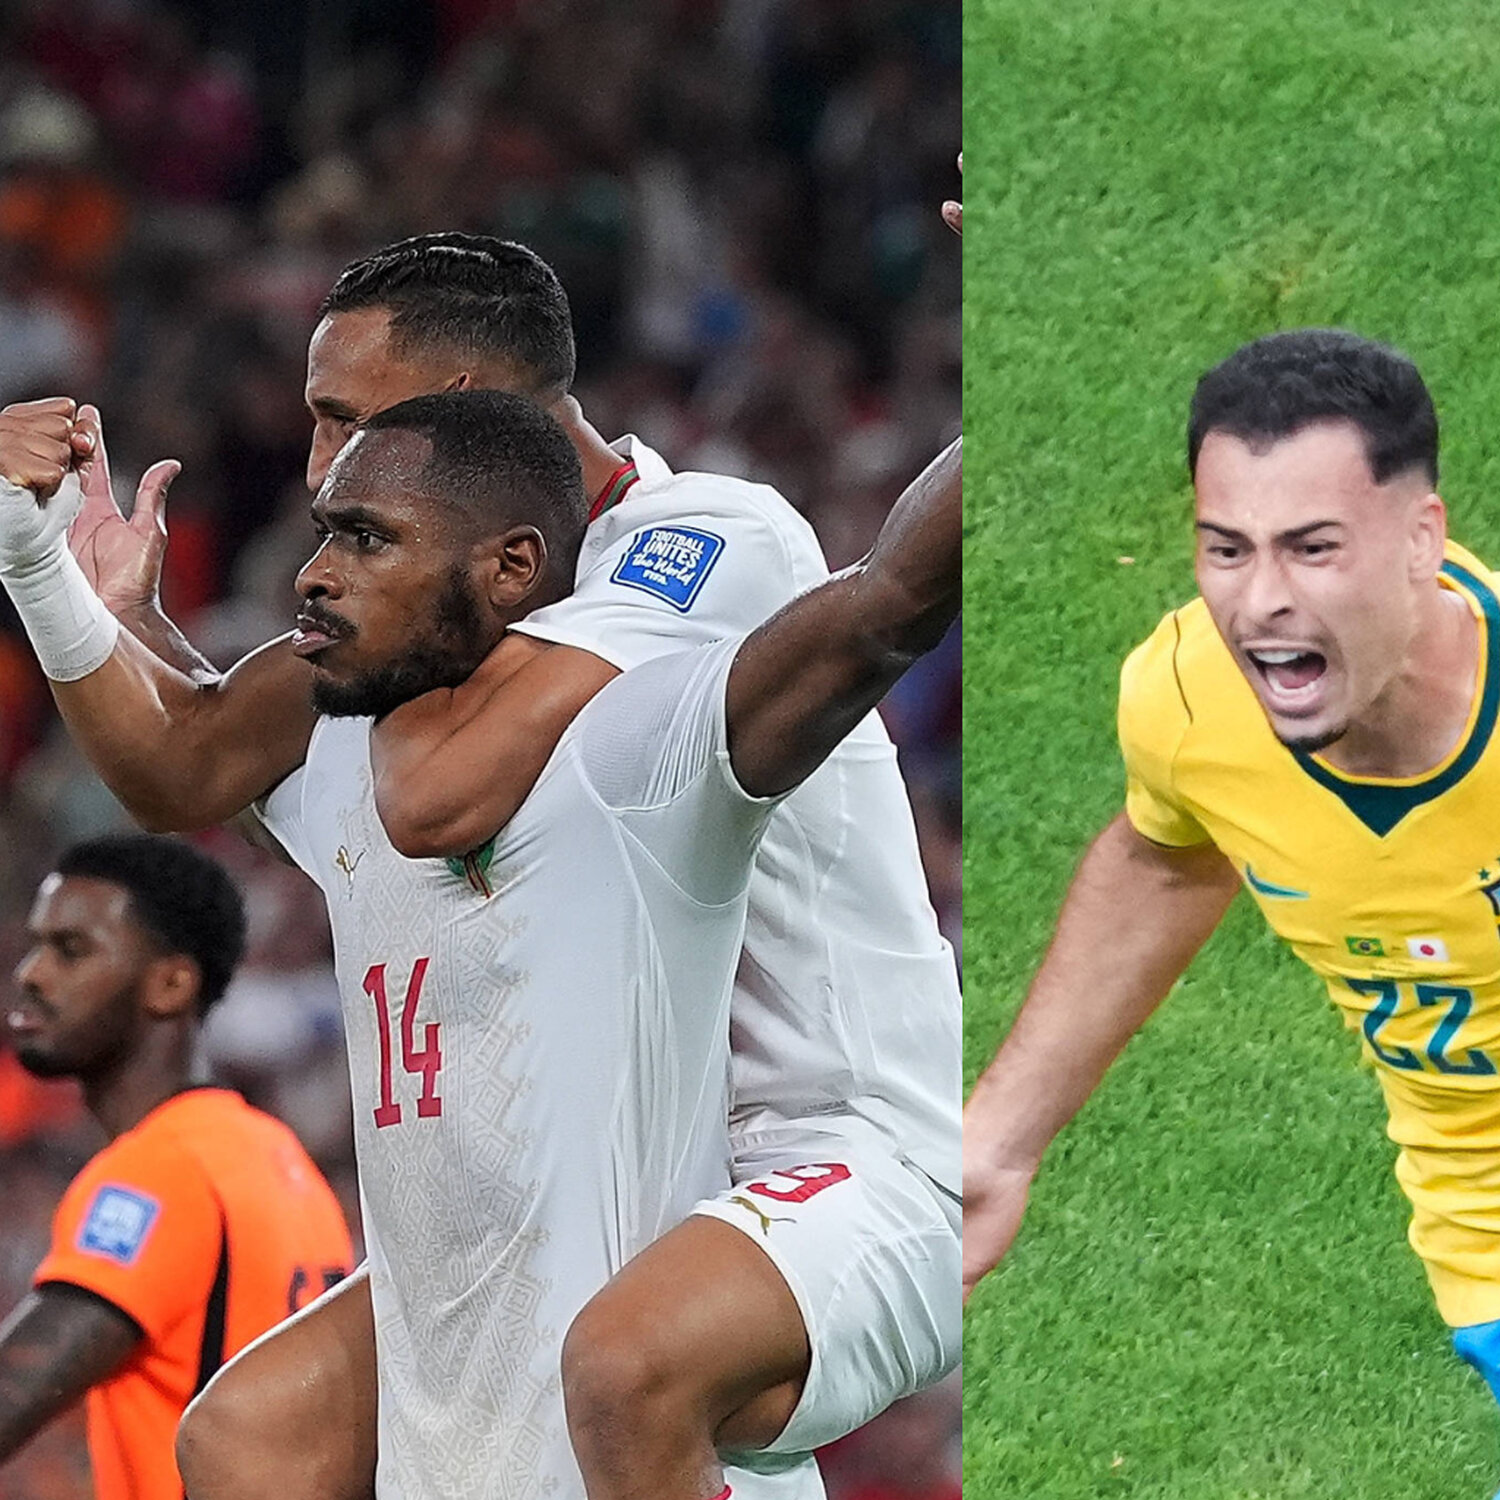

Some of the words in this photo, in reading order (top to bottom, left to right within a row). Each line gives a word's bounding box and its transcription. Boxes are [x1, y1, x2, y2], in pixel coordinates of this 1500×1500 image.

[642, 541, 700, 569] UNITES
[650, 530, 705, 555] FOOTBALL
[632, 552, 655, 568] the
[653, 558, 697, 586] World
[642, 569, 668, 586] FIFA
[1344, 976, 1497, 1075] 22
[362, 957, 442, 1129] 14
[746, 1163, 853, 1203] 9
